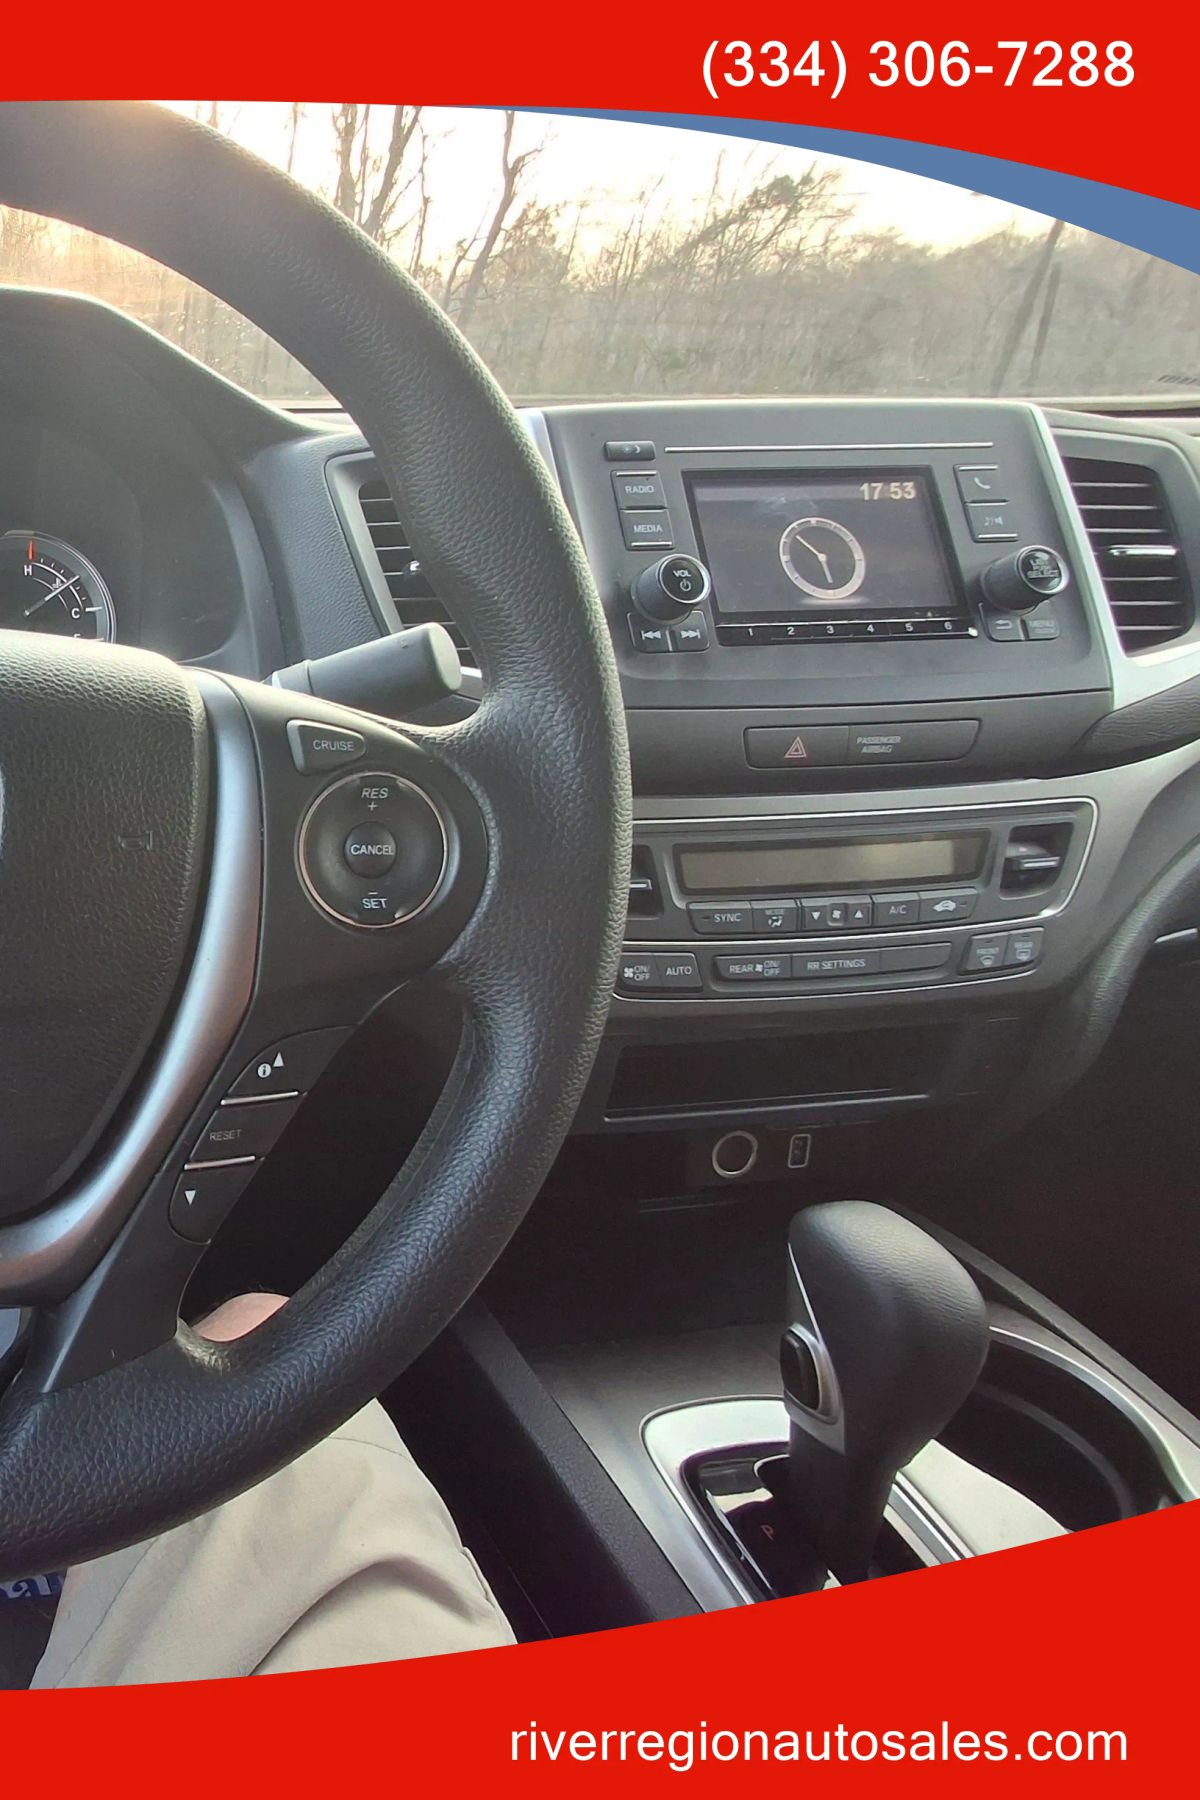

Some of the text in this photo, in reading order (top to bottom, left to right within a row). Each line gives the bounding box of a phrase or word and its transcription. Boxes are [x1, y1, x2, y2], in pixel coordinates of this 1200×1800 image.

[625, 485, 654, 494] RADIO
[633, 524, 663, 534] MEDIA
[23, 564, 33, 576] H
[673, 570, 692, 578] VOL
[71, 607, 80, 619] C
[748, 621, 953, 637] 1 2 3 4 5 6
[312, 739, 355, 752] CRUISE
[361, 787, 389, 799] RES
[350, 844, 395, 856] CANCEL
[361, 898, 388, 909] SET
[889, 905, 907, 915] A/C
[714, 913, 742, 923] SYNC
[729, 964, 754, 974] REAR
[807, 958, 866, 971] RR SETTINGS
[666, 966, 692, 976] AUTO
[763, 968, 780, 977] OFF
[633, 973, 650, 982] OFF
[209, 1129, 242, 1141] RESET
